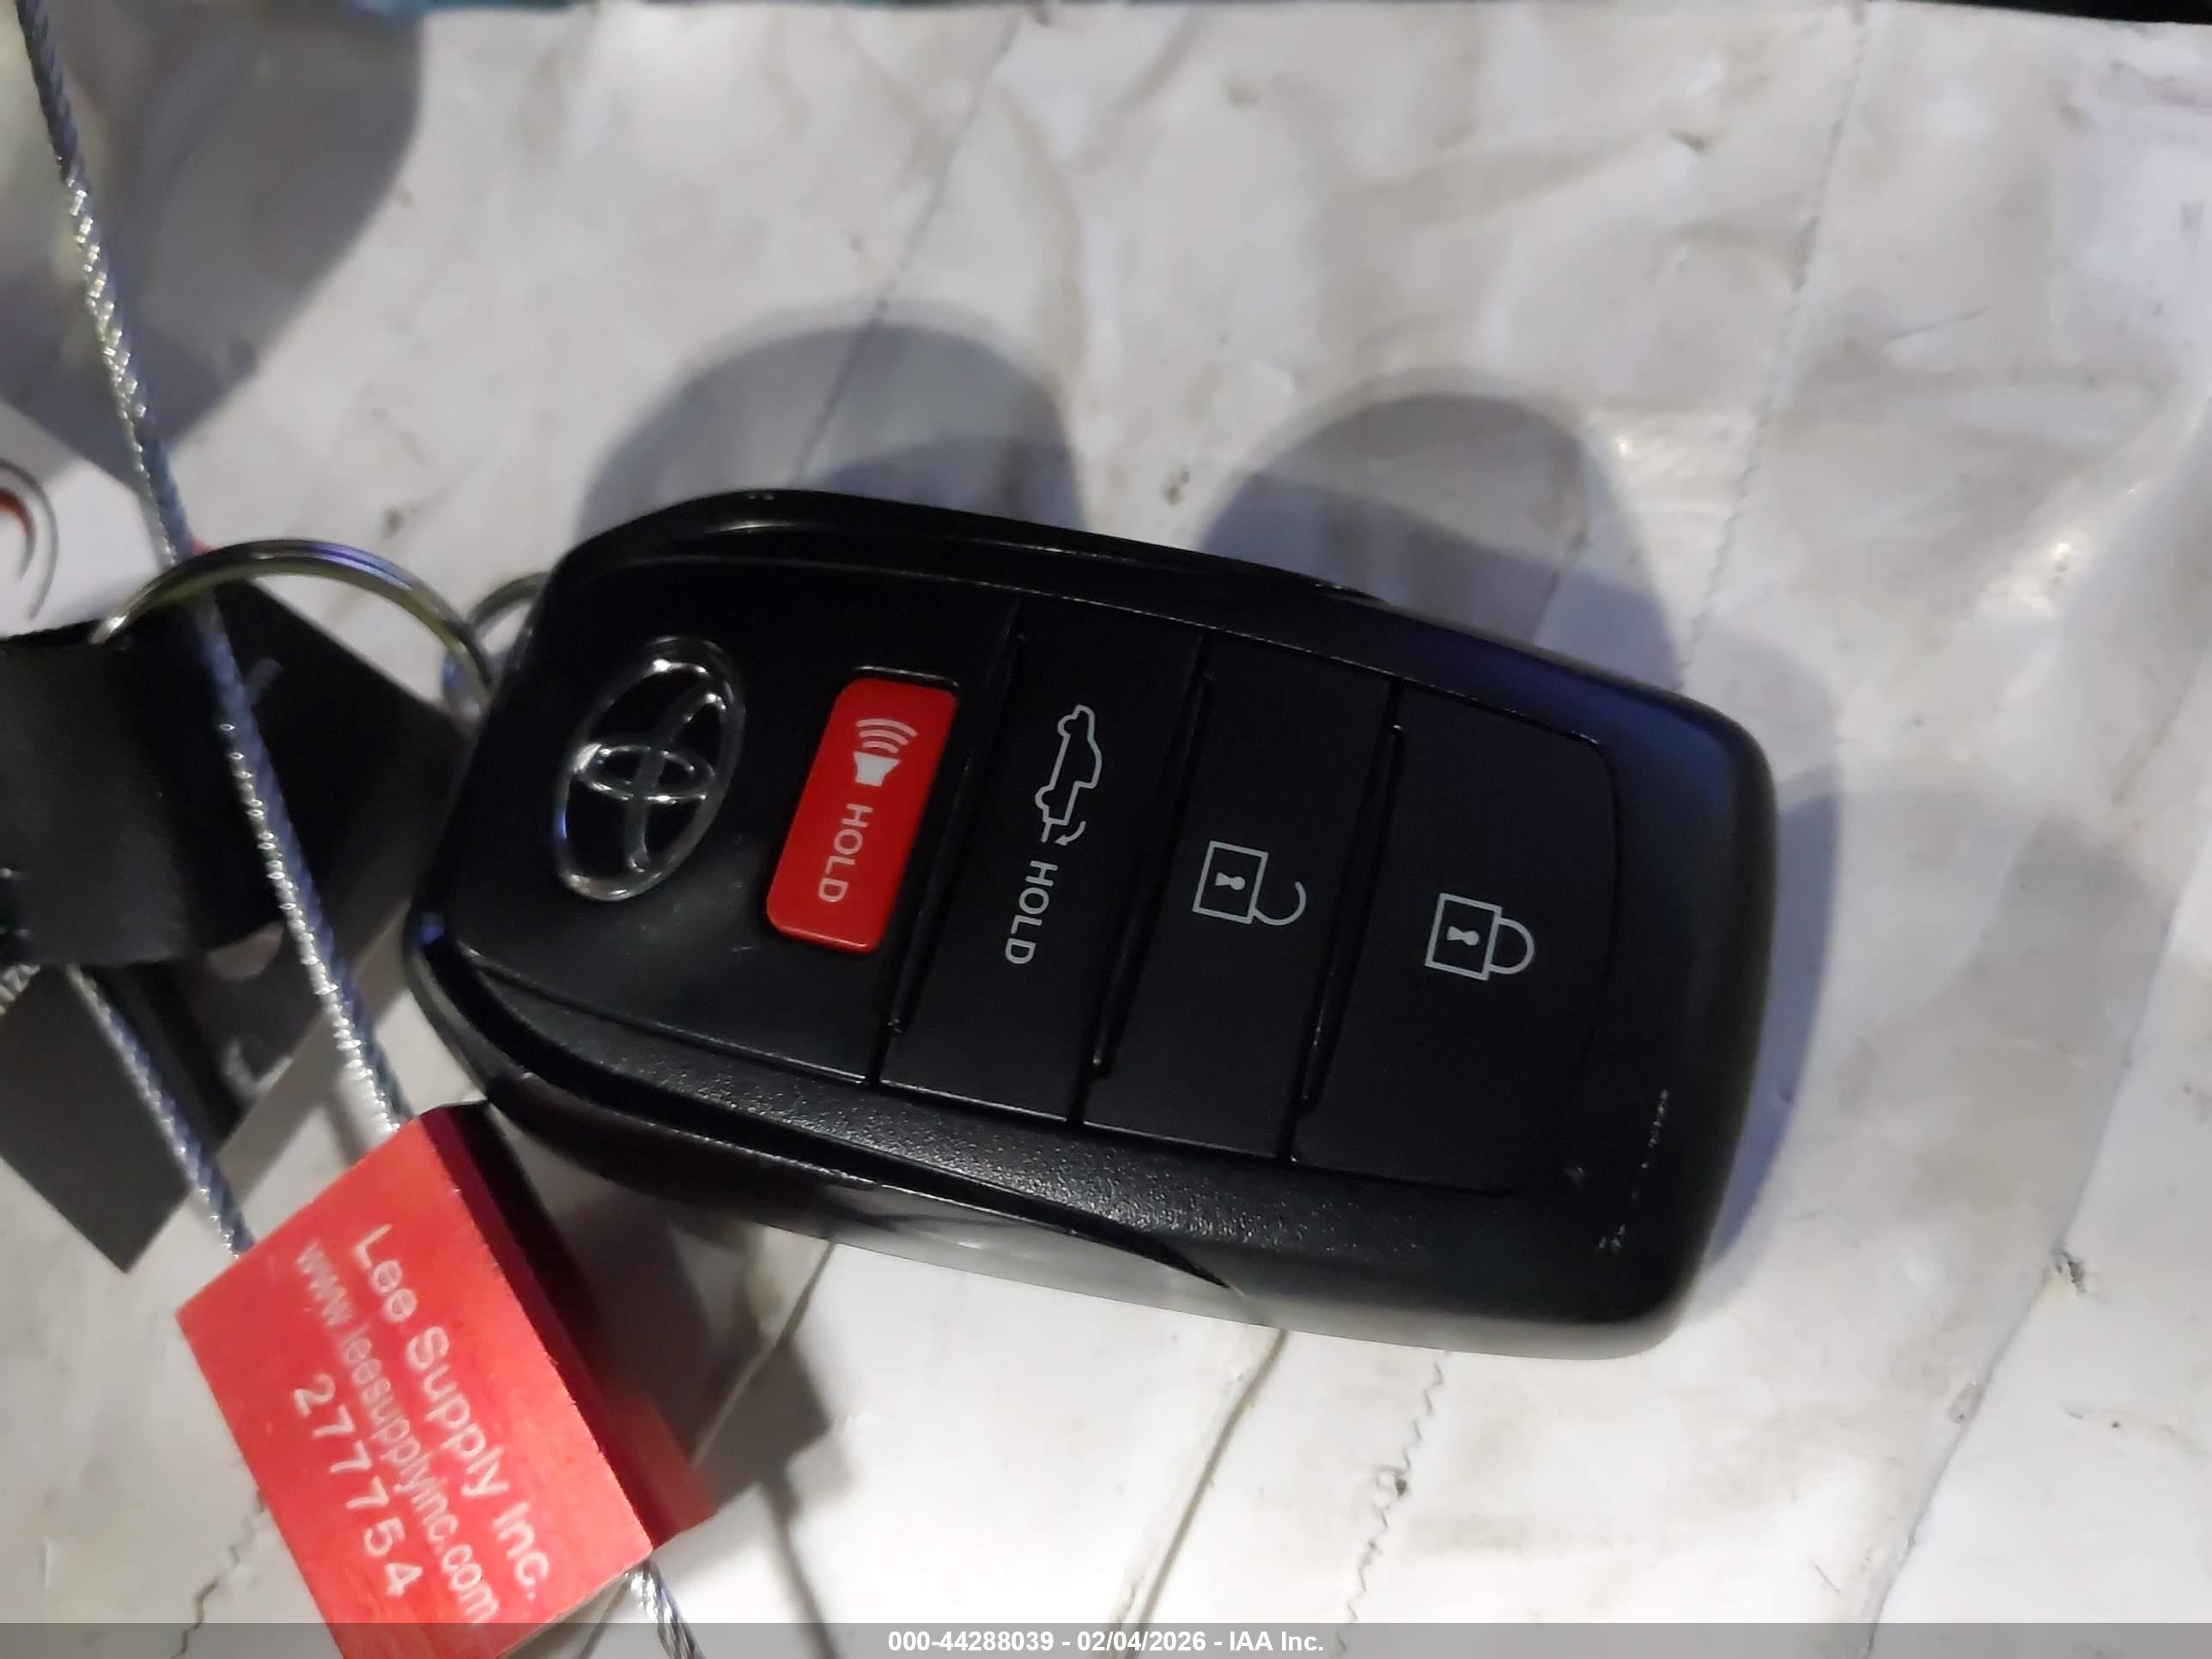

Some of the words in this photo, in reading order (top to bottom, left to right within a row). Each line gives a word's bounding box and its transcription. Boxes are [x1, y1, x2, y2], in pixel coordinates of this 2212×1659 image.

[818, 804, 873, 903] HOLD
[1005, 860, 1059, 964] HOLD
[293, 1374, 423, 1596] 277754
[295, 1241, 500, 1627] www.leesupplyinc.com
[351, 1223, 418, 1324] Lee
[406, 1327, 509, 1499] Supply
[492, 1503, 550, 1600] Inc.
